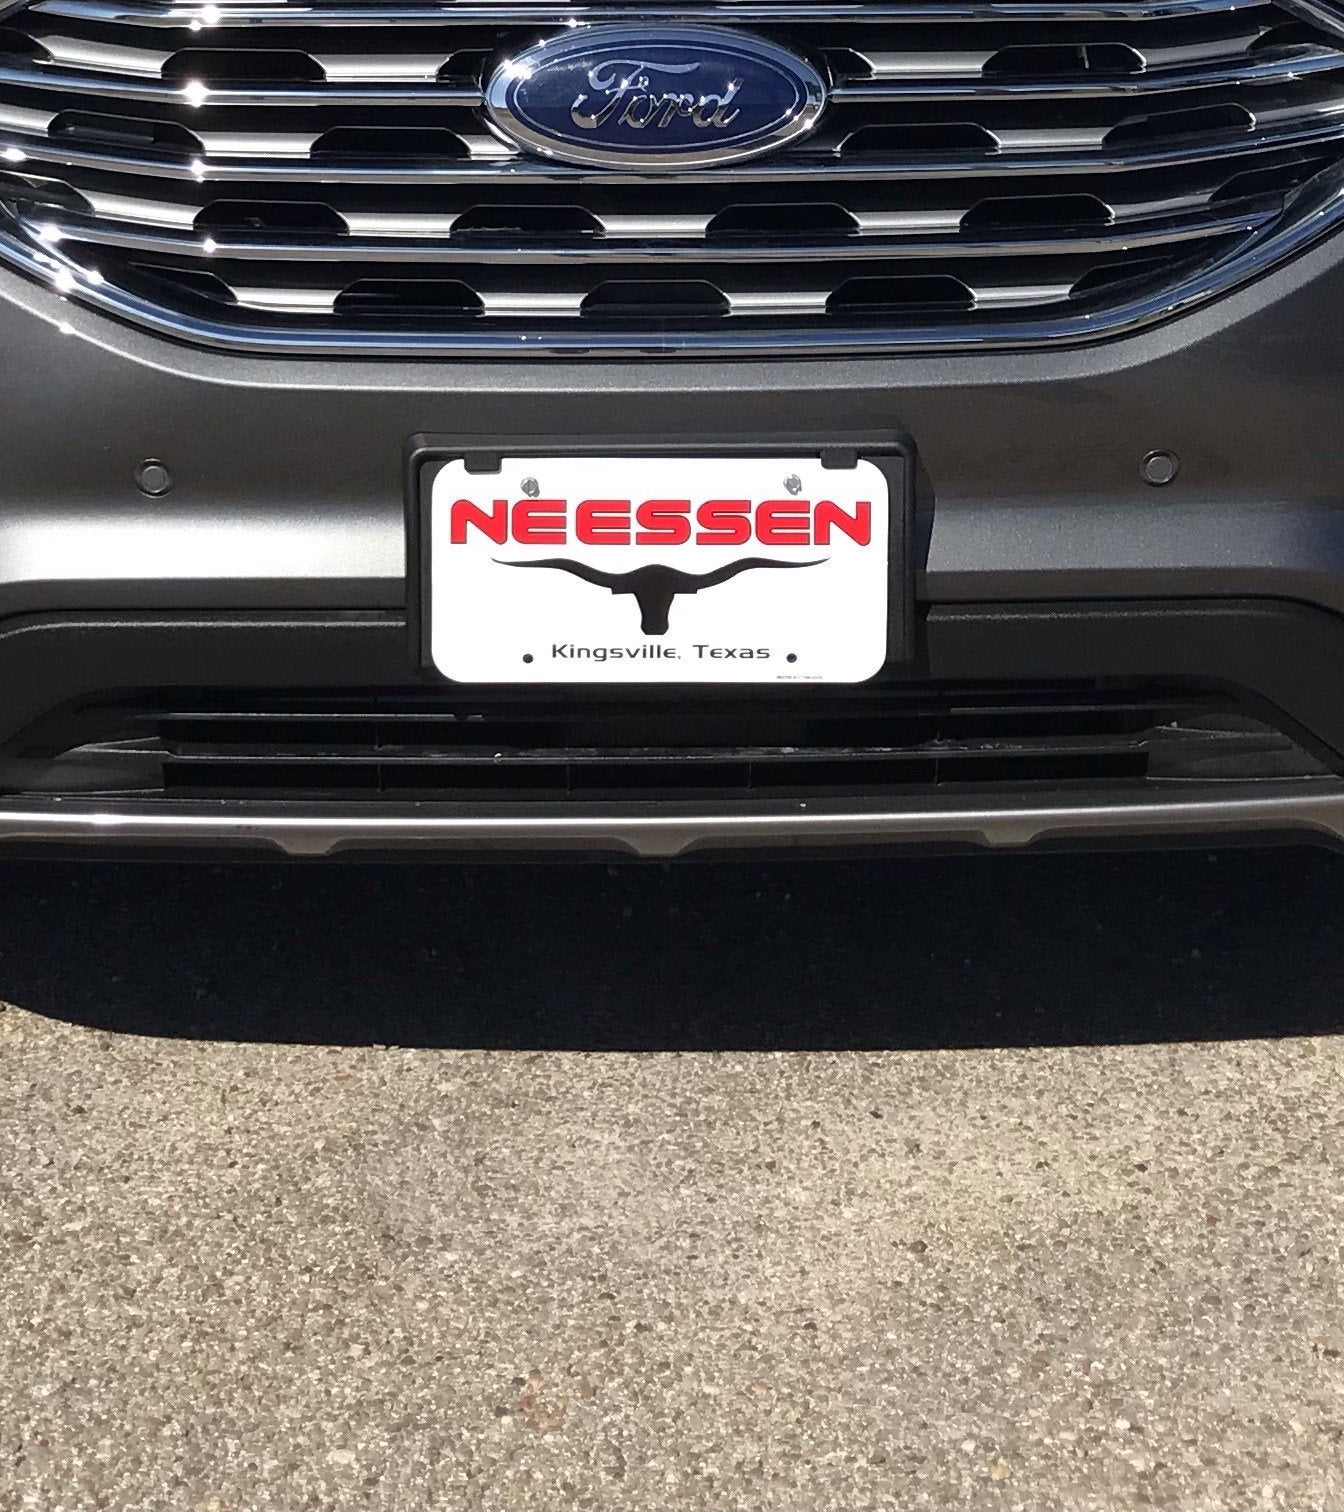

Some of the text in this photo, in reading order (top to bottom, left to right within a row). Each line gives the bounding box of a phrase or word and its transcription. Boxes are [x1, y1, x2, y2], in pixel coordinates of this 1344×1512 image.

[570, 59, 743, 130] Ford
[450, 499, 872, 547] NEESSEN
[551, 643, 771, 663] Kingsville, Texas
